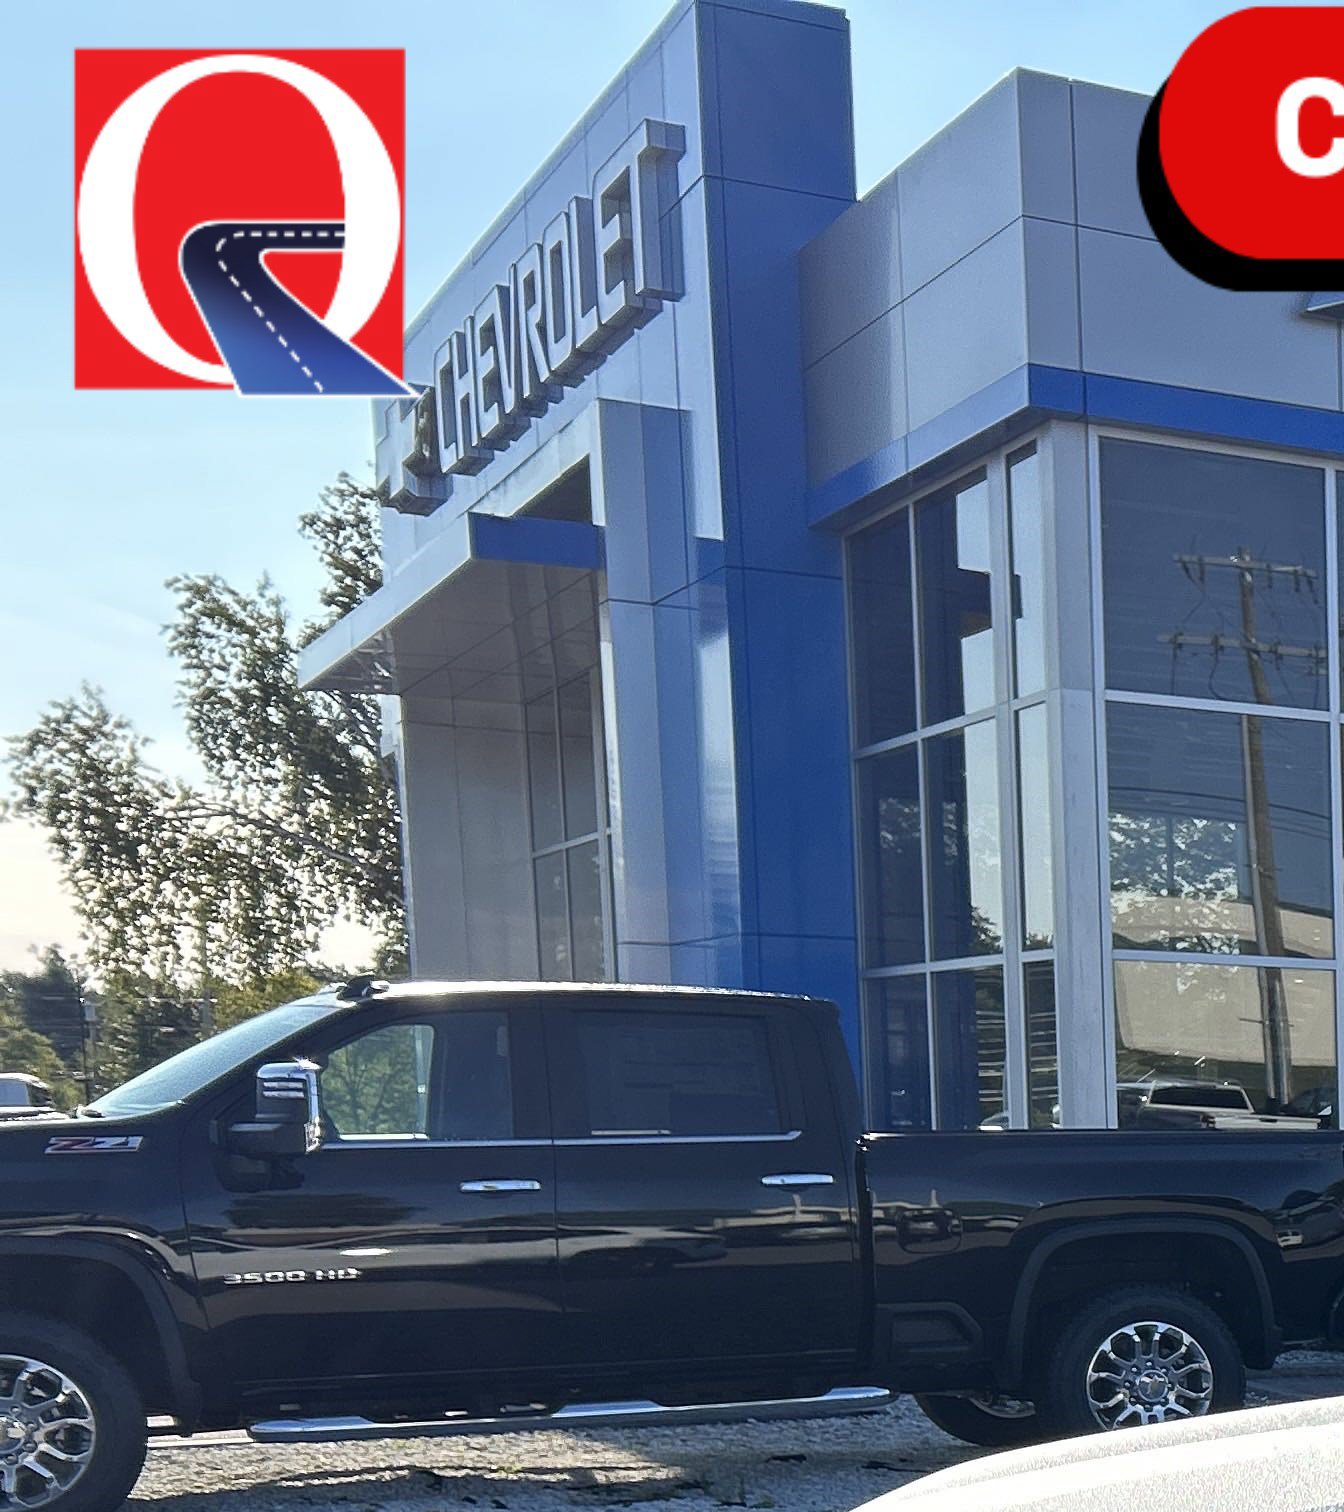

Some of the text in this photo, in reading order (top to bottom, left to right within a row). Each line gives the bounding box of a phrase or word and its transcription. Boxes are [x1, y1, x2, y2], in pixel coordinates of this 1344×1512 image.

[432, 118, 686, 477] CHEVROLET
[223, 1266, 362, 1285] 3500 HD
